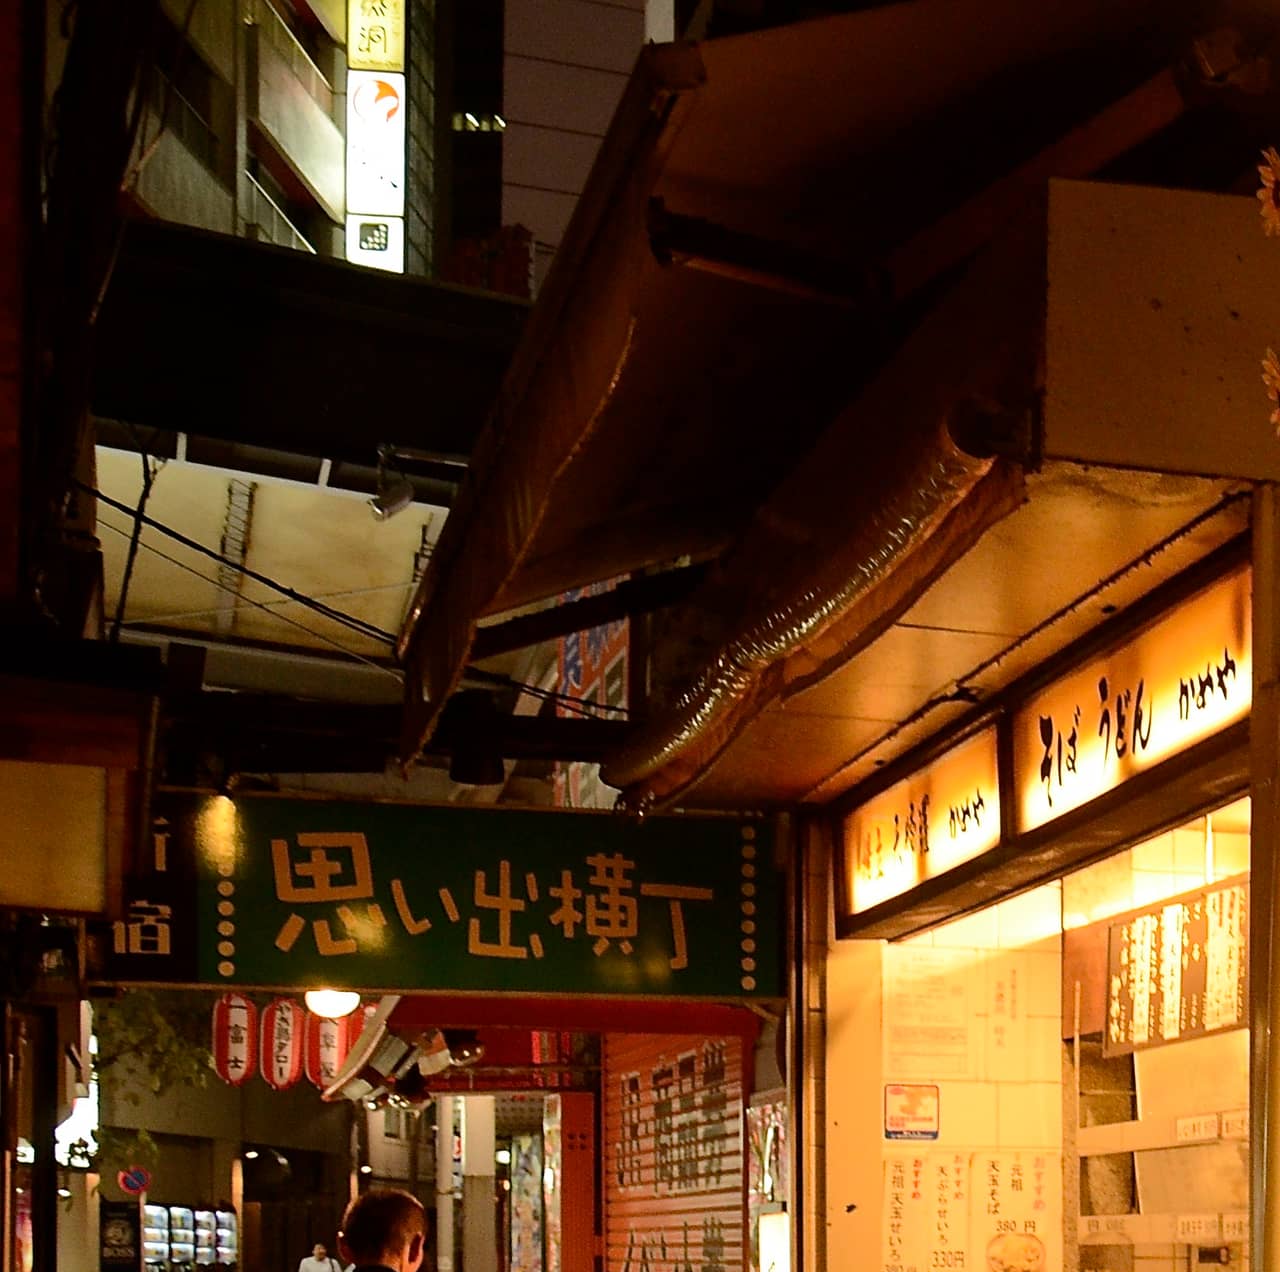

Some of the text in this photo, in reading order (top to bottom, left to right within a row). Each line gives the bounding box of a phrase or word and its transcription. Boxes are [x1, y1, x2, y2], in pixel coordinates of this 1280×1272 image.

[1039, 705, 1081, 807] そば
[1098, 677, 1152, 768] うどん
[271, 831, 714, 970] 思い出横丁
[228, 1004, 249, 1070] 一富士
